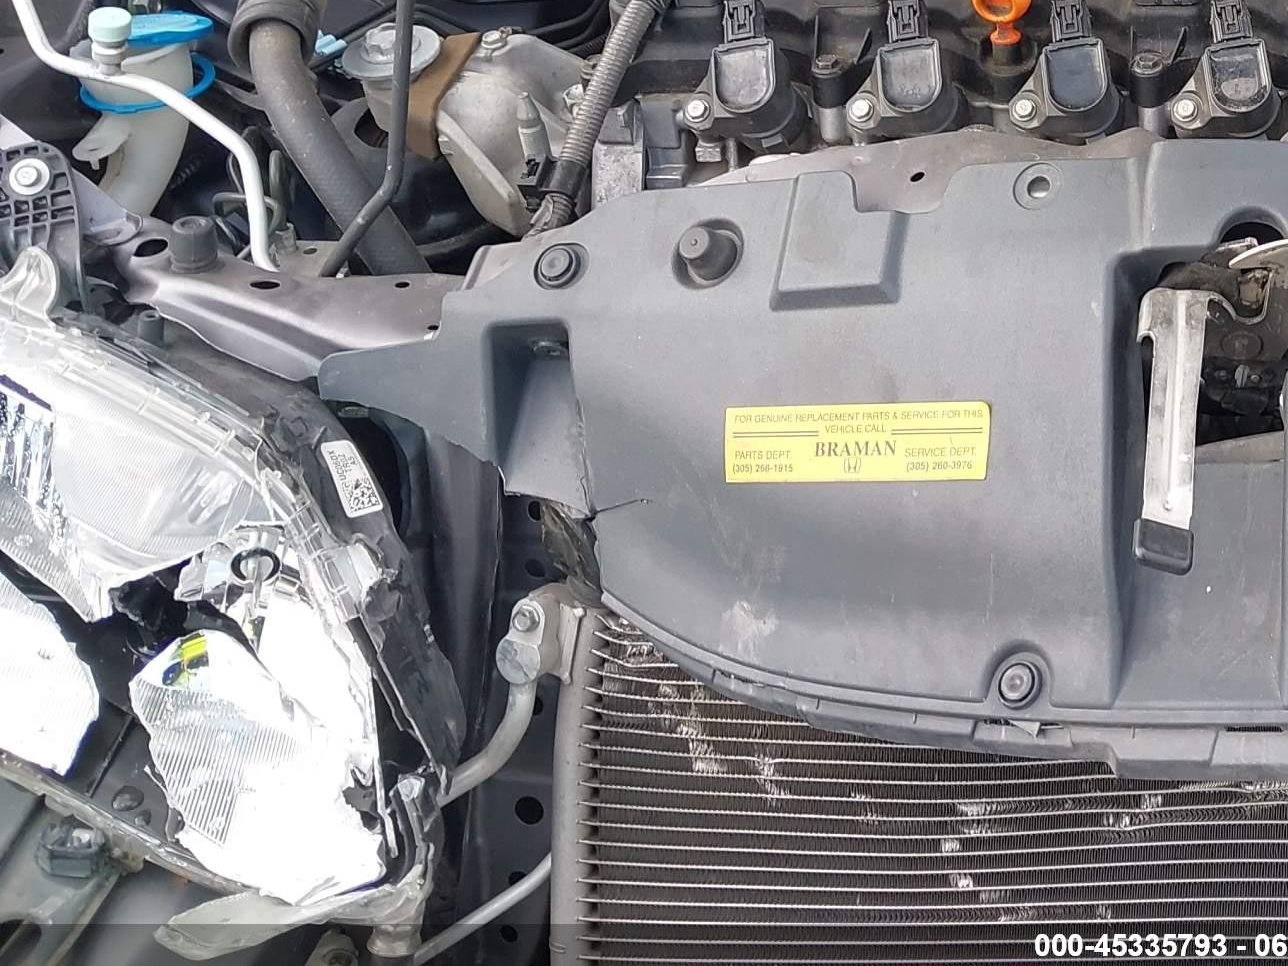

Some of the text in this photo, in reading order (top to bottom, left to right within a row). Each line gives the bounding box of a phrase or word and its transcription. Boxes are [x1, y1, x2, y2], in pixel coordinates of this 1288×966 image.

[734, 409, 983, 424] FOR GENUINE REPLACEMENT PARTS & SERVICE FOR THIS
[824, 423, 887, 434] VEHICLE CALL
[814, 440, 897, 457] BRAMAN
[904, 447, 946, 458] SERVICE
[734, 450, 763, 460] PARTS
[732, 463, 753, 474] (305)
[906, 461, 929, 473] (305)
